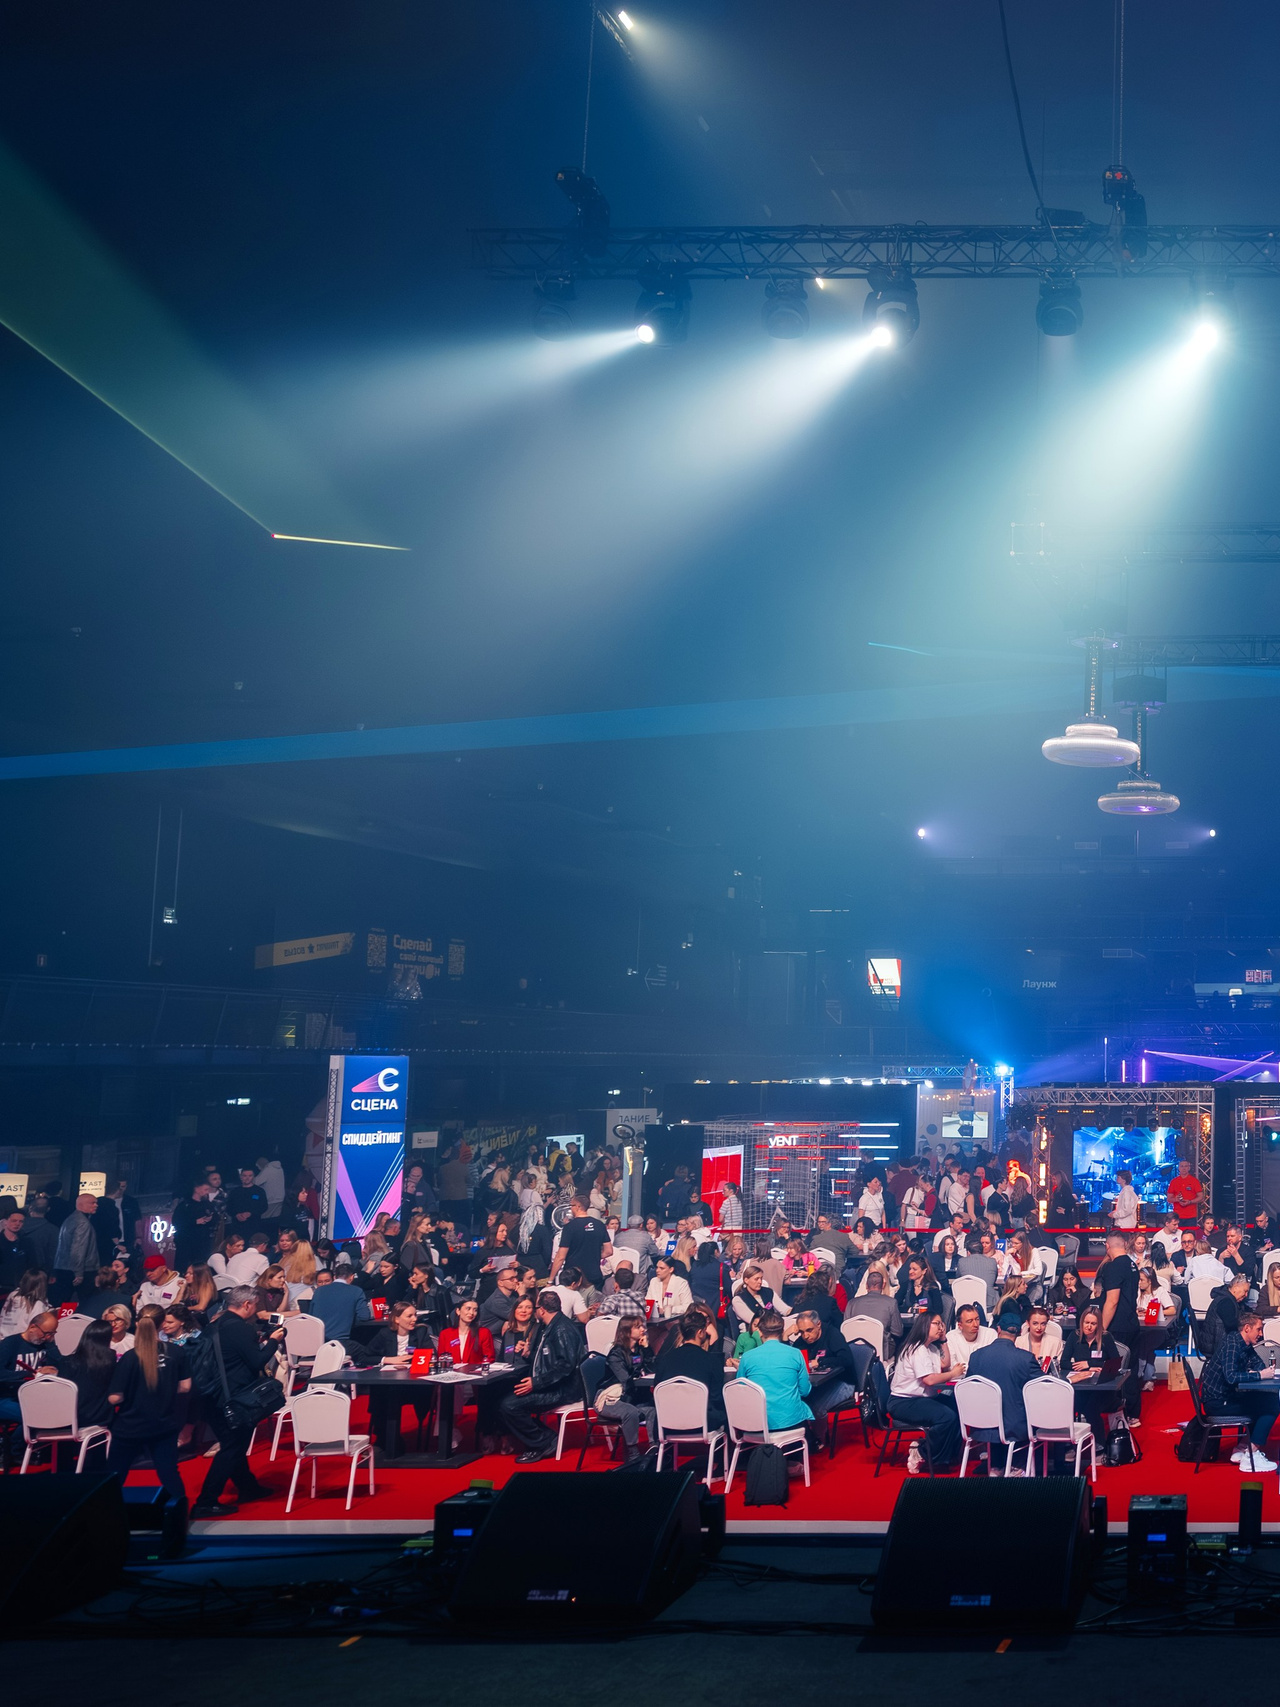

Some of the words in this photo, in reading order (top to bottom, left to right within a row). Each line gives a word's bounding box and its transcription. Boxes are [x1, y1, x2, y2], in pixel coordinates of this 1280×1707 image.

[1022, 979, 1057, 990] Лаунж
[350, 1098, 399, 1112] СЦЕНА
[342, 1130, 403, 1146] СПИДДЕЙТИНГ
[5, 1184, 24, 1192] AST
[61, 1308, 74, 1317] 20
[1148, 1307, 1157, 1316] 16
[417, 1356, 426, 1365] 3
